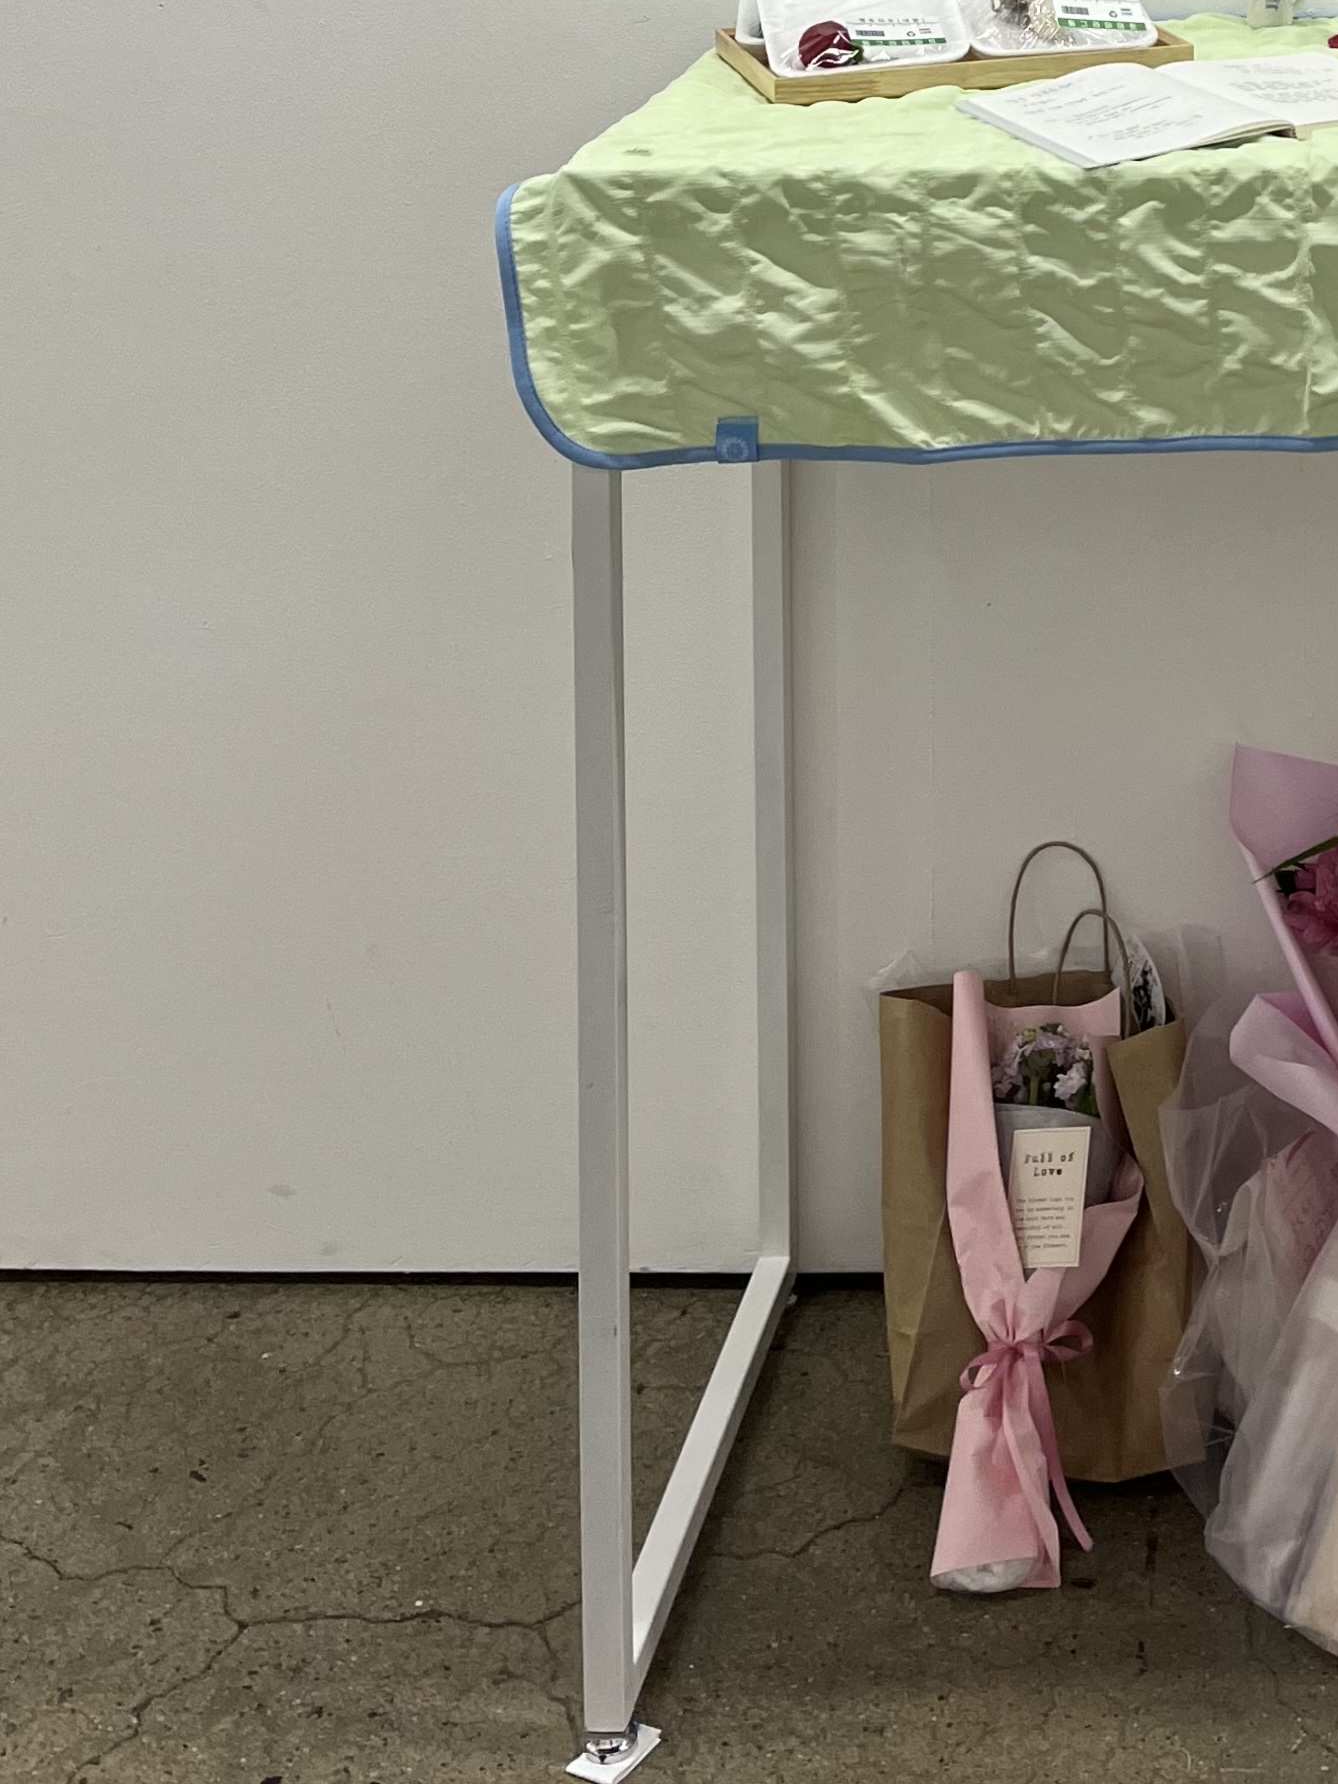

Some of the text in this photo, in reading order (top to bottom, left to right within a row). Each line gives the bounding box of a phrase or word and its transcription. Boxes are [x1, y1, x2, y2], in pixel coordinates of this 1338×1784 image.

[1023, 1151, 1075, 1165] Full of
[1033, 1167, 1063, 1177] Love
